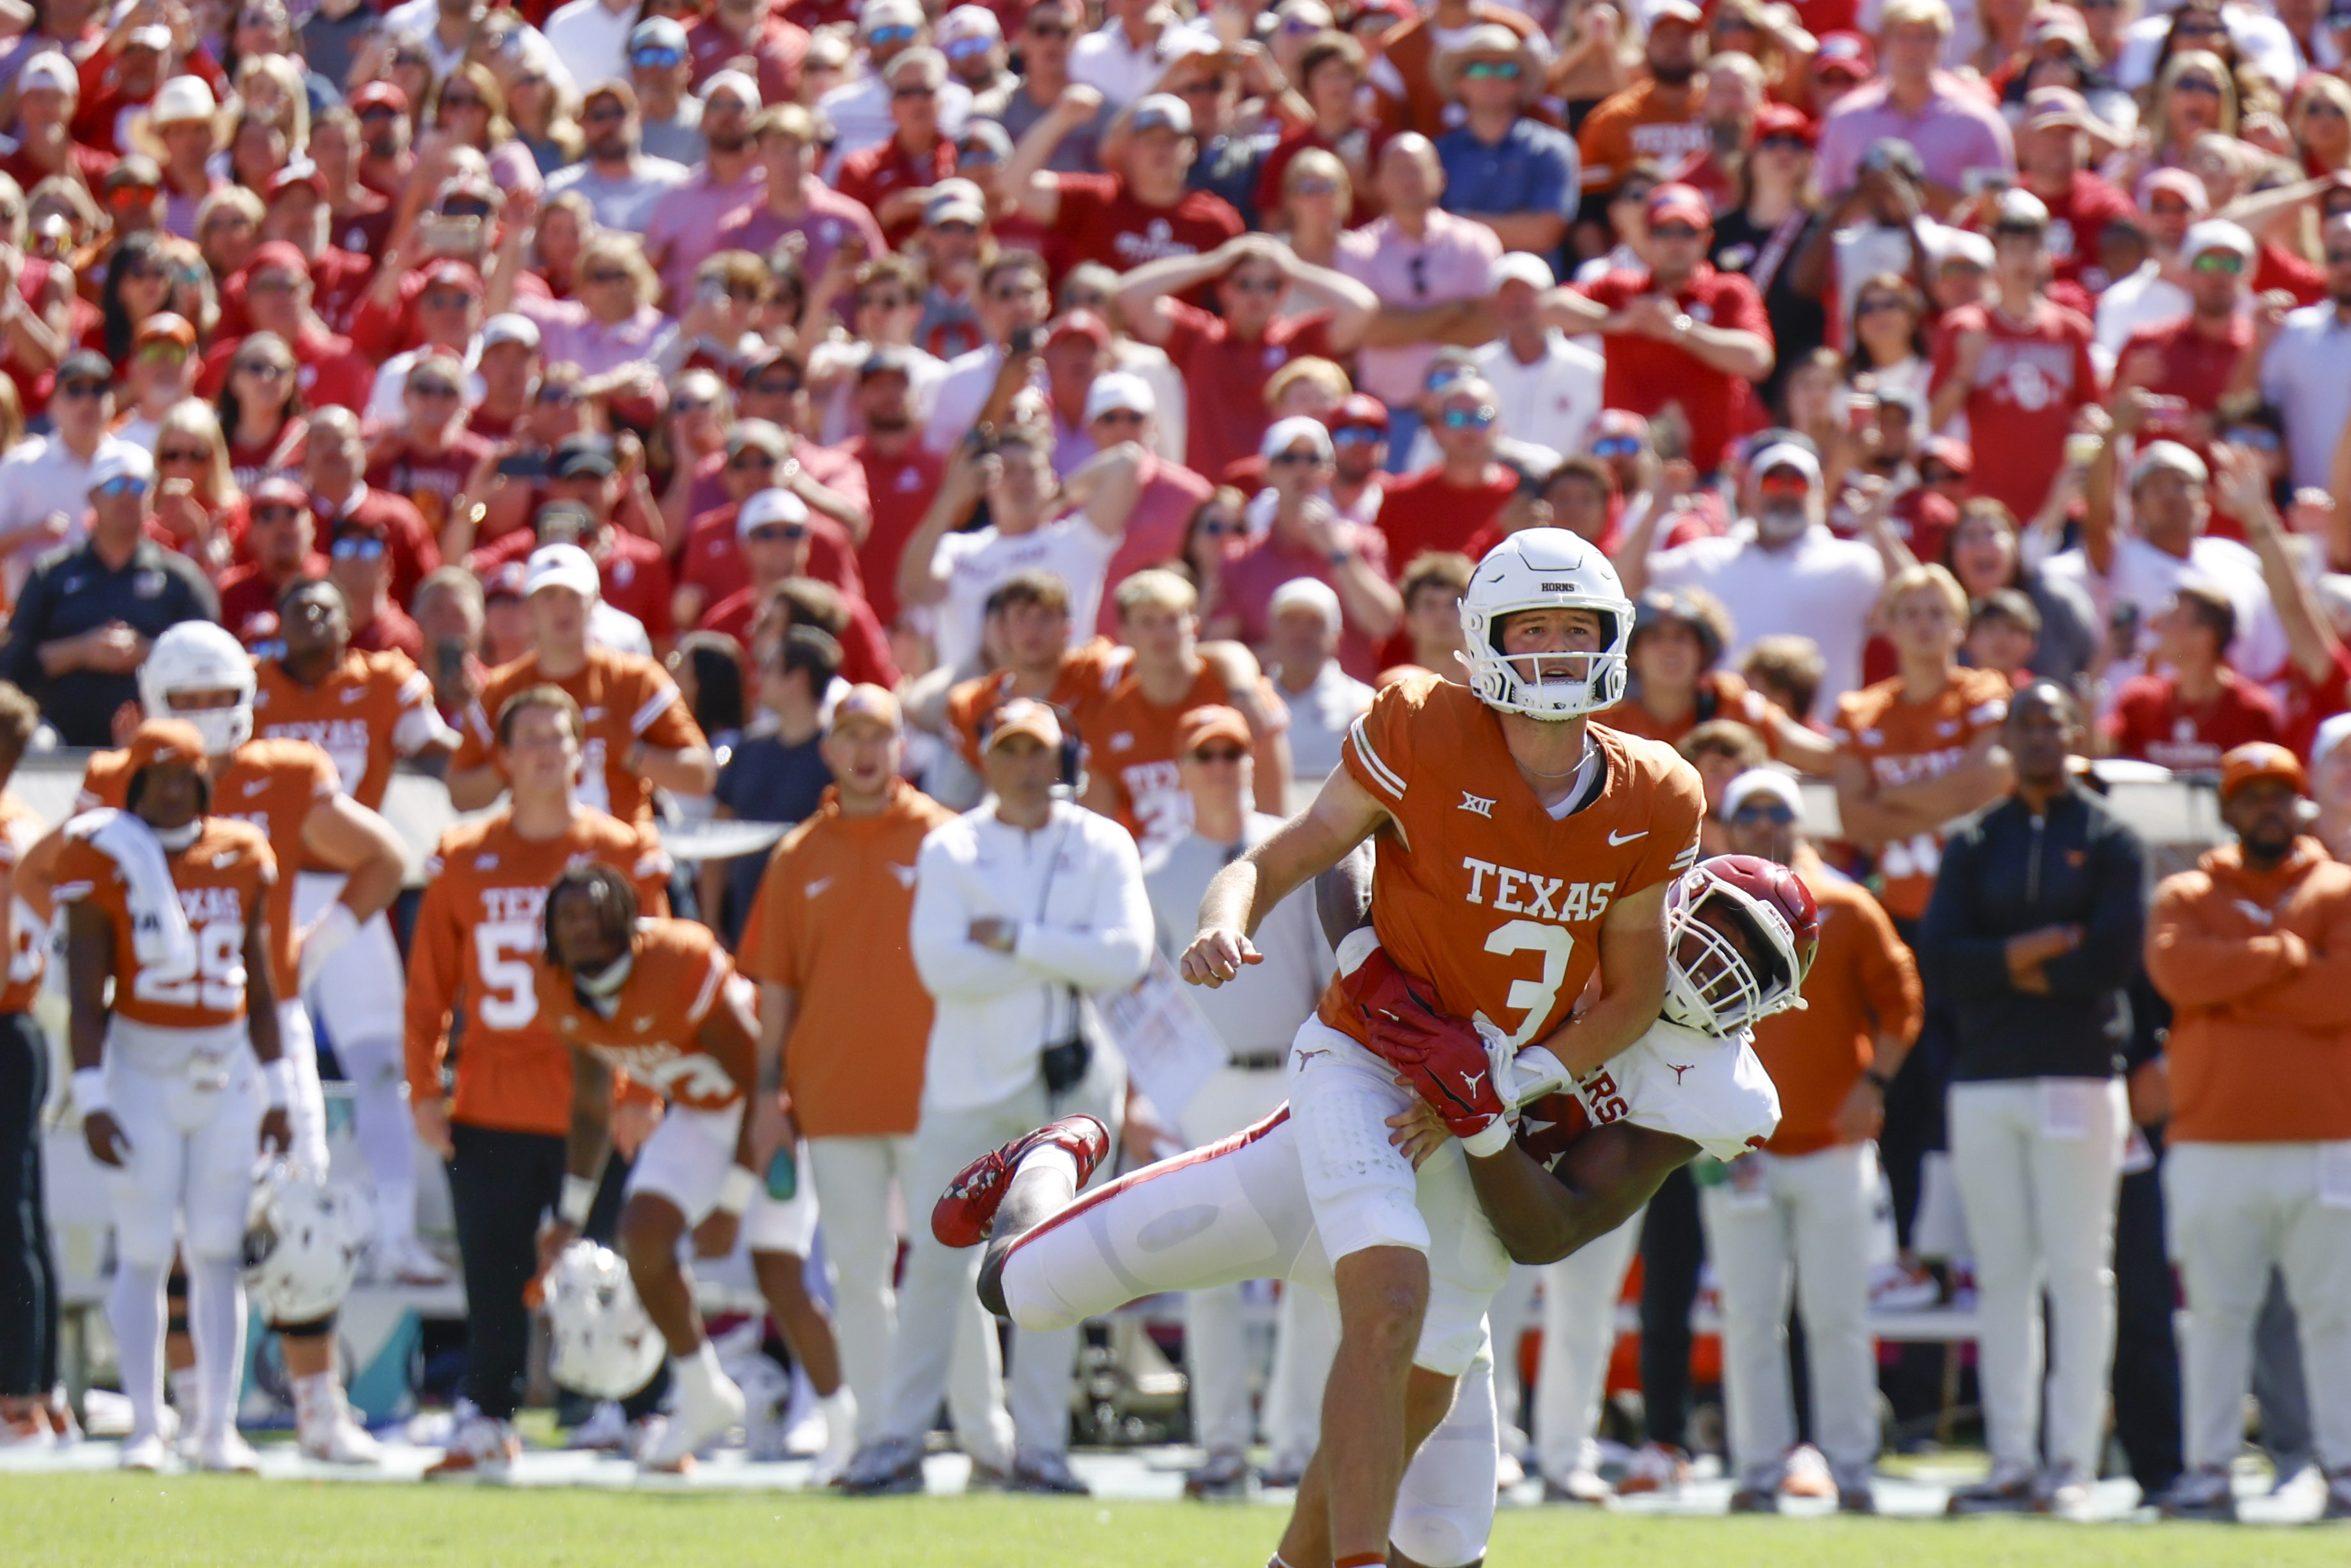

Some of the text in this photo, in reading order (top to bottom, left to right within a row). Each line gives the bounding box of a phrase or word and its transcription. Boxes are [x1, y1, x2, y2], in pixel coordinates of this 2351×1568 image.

[1541, 582, 1575, 593] HORNS
[1457, 790, 1498, 819] XII
[1463, 856, 1617, 921] TEXAS
[1484, 919, 1575, 1055] 3
